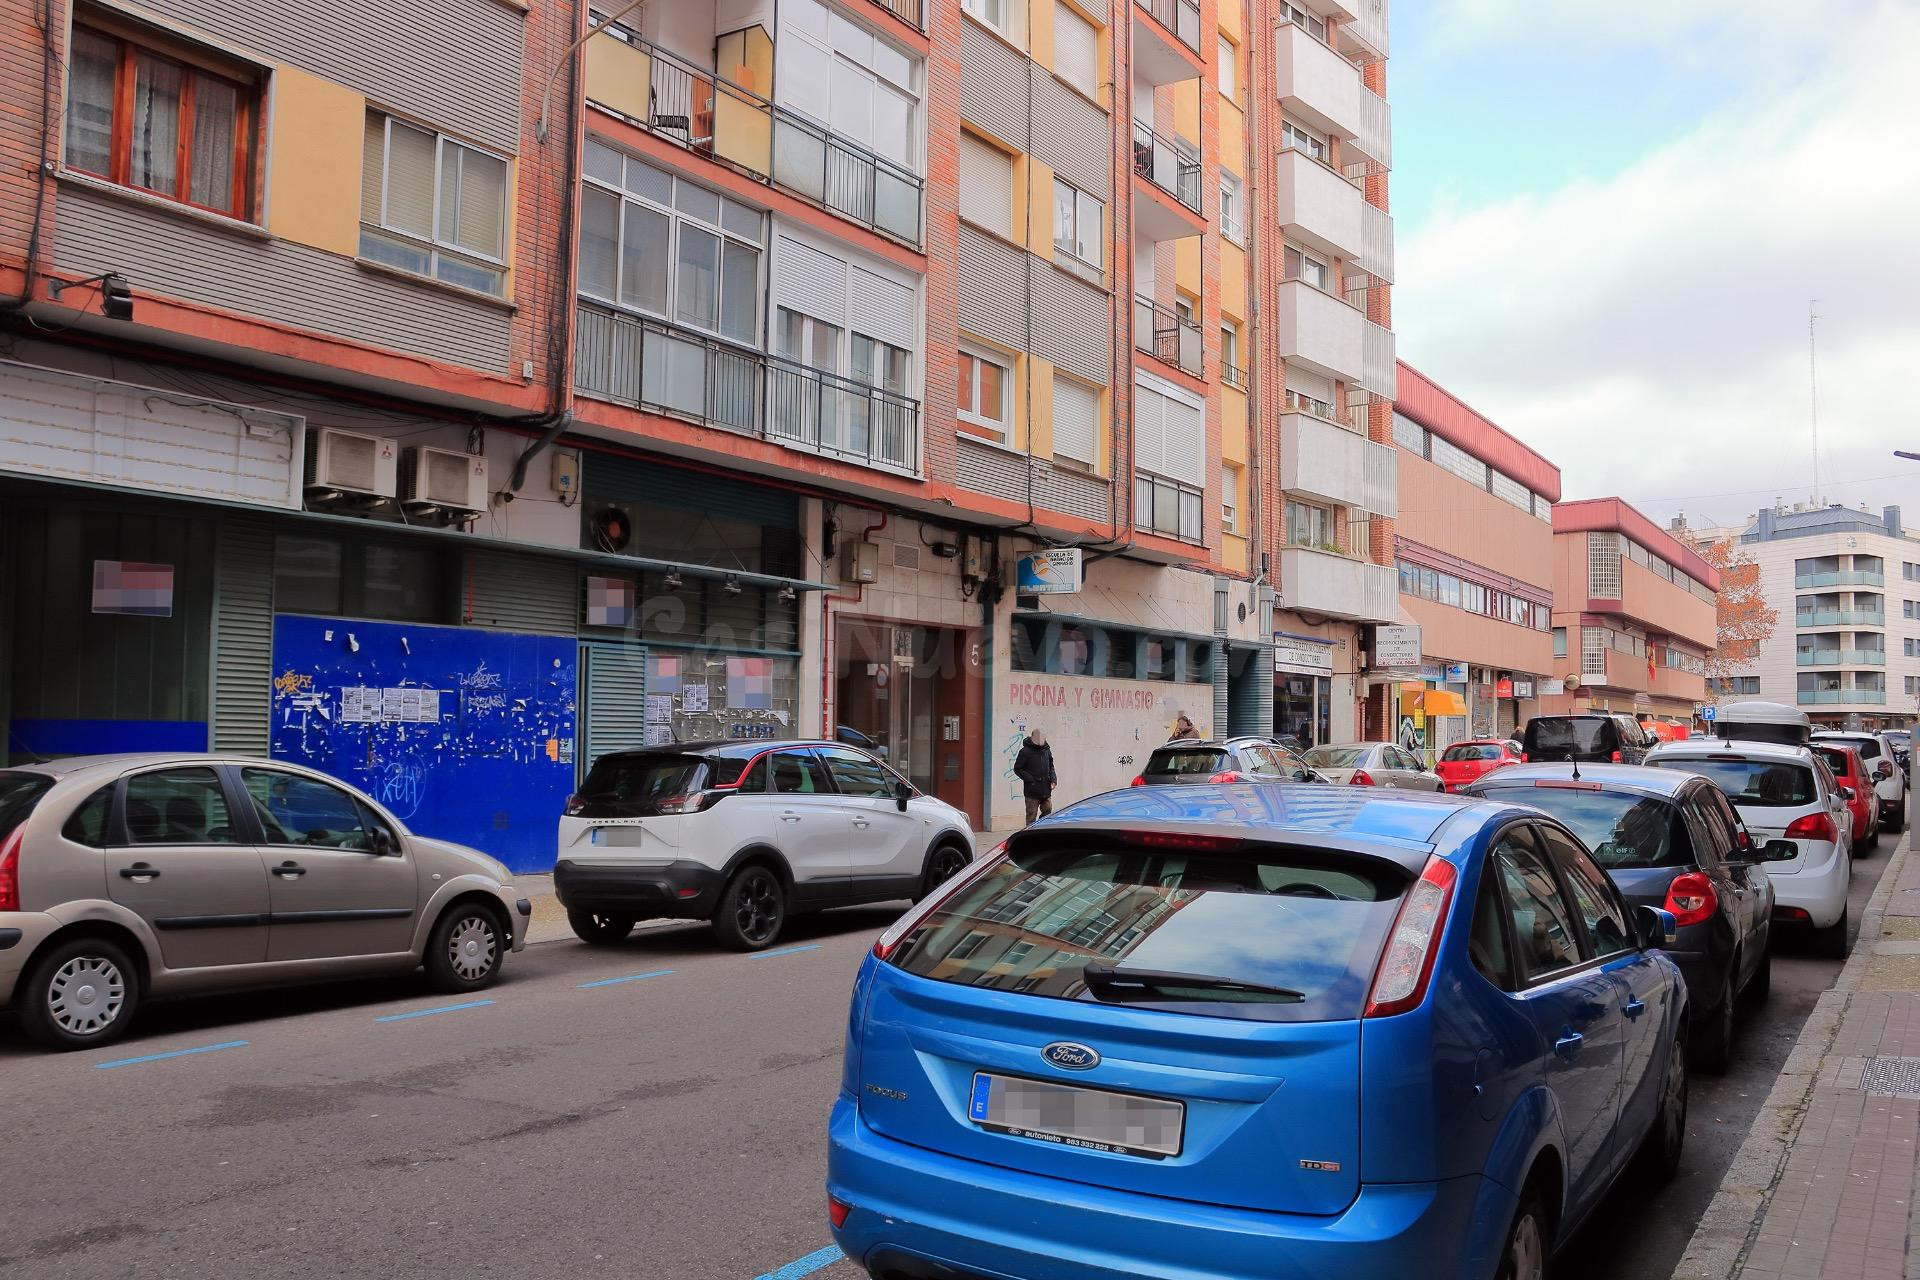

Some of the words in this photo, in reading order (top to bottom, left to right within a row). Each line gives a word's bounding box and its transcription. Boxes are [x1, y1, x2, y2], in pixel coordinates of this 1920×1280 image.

[971, 644, 979, 666] 5
[1009, 683, 1067, 707] PISCINA
[1074, 687, 1083, 708] Y
[1090, 687, 1154, 711] GIMNASIO
[1704, 708, 1714, 719] P
[1052, 1044, 1086, 1065] Ford
[865, 1083, 907, 1101] FOCUS
[975, 1102, 984, 1113] E
[1024, 1130, 1061, 1143] autonieto
